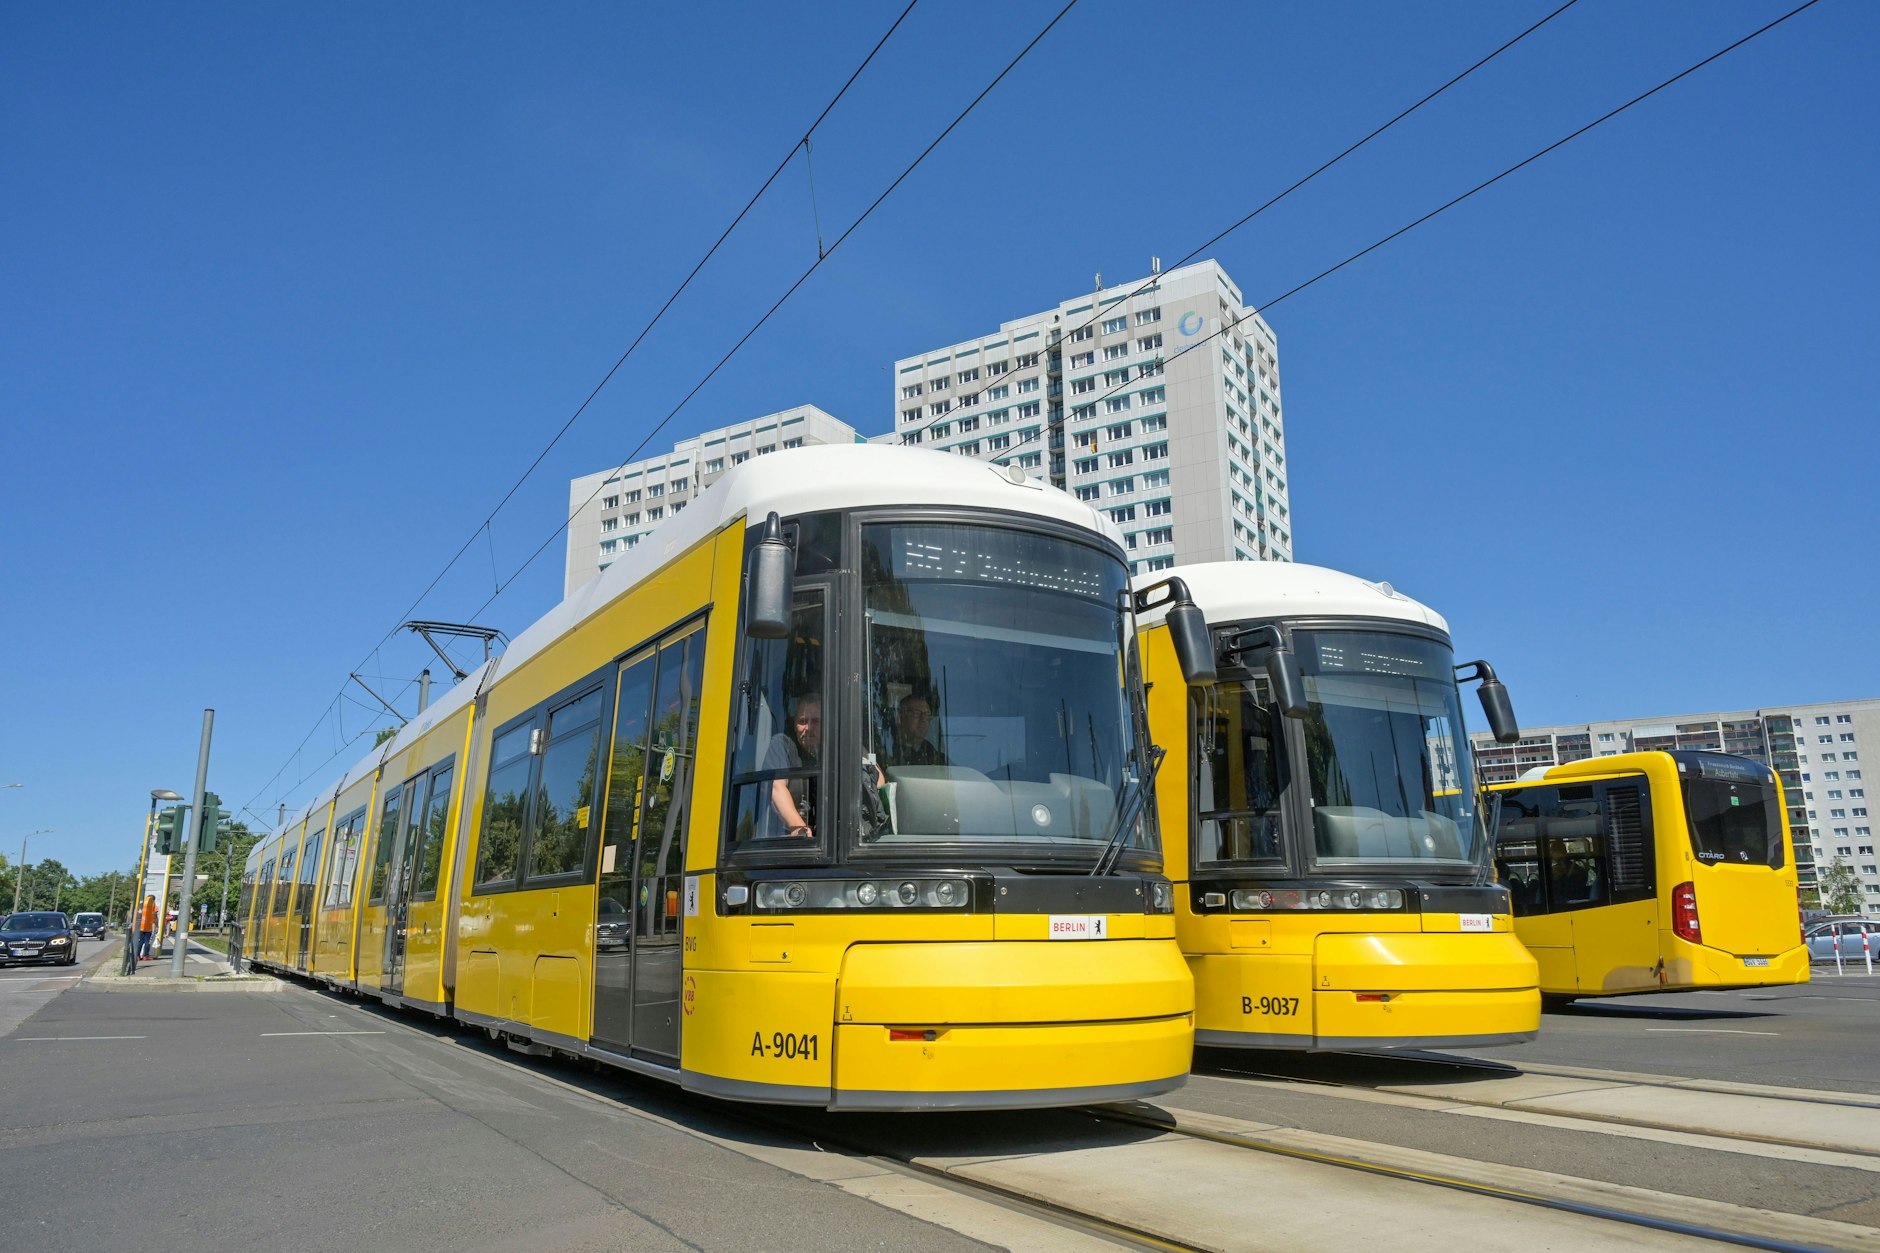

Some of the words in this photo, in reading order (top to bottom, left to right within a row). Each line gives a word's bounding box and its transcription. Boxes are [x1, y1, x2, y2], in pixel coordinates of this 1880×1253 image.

[1053, 922, 1086, 932] BERLIN
[1463, 919, 1482, 927] BERLIN
[685, 936, 697, 952] BVG
[684, 990, 695, 1002] VBB
[1242, 996, 1299, 1016] B-9037
[751, 1031, 818, 1061] A-9041
